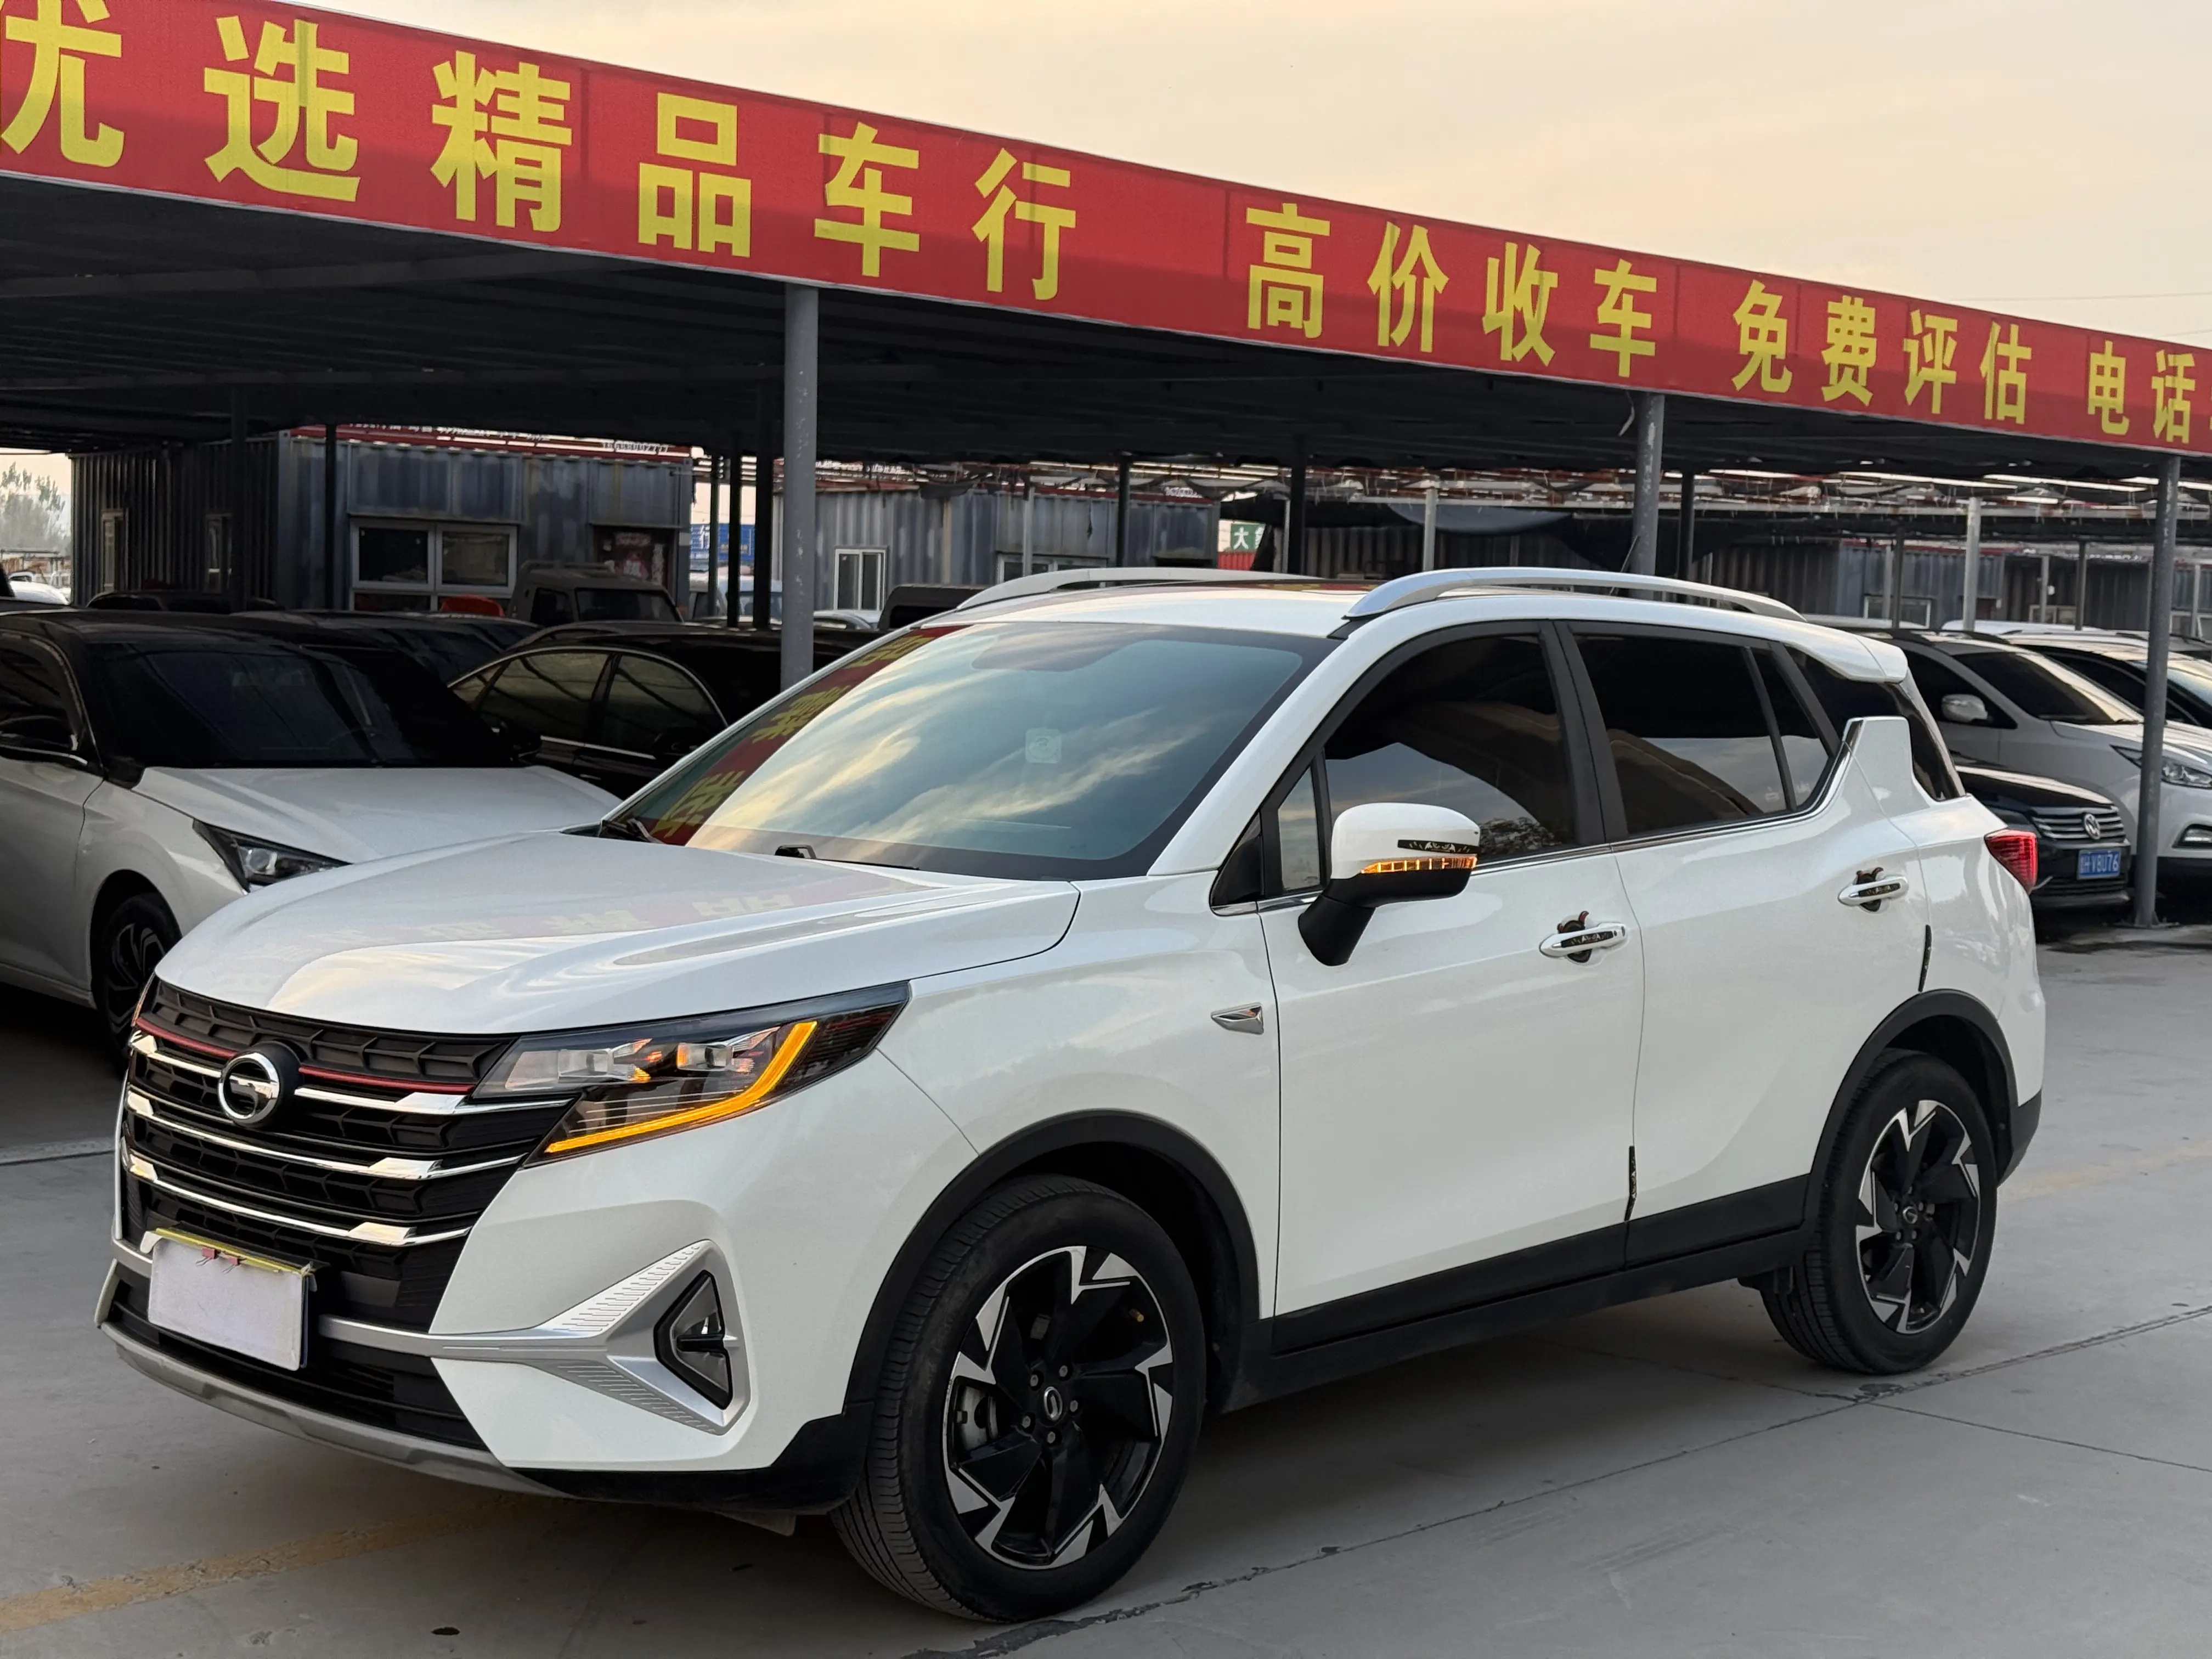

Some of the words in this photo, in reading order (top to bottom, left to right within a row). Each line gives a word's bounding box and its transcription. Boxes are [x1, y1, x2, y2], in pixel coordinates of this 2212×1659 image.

[1246, 202, 1657, 377] 高价收车
[1732, 279, 2032, 425] 免费评估
[2088, 341, 2196, 444] 电话
